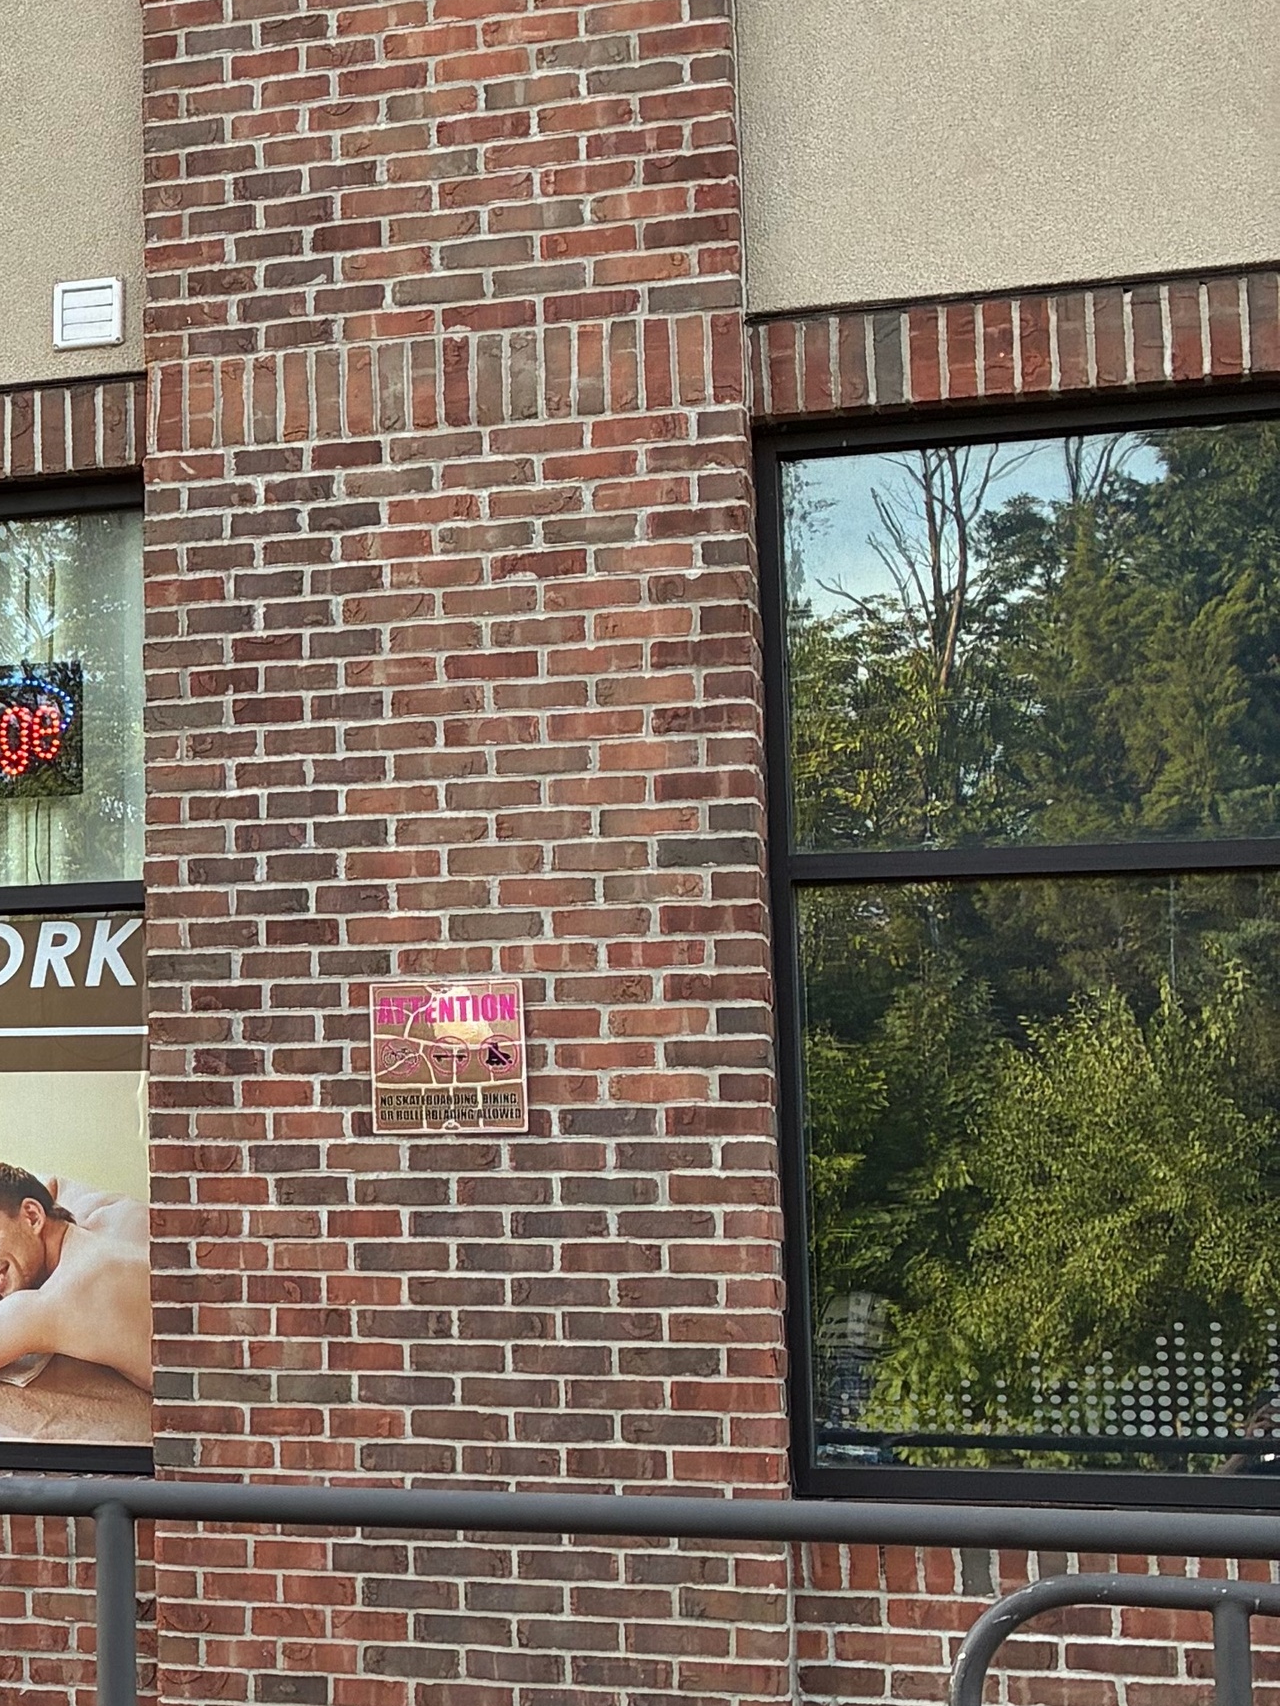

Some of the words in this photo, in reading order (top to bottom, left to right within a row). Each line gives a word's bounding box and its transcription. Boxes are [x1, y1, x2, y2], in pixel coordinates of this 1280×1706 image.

[377, 993, 516, 1024] ATTENTION
[380, 1095, 393, 1107] NO
[477, 1107, 522, 1120] ALLOWED
